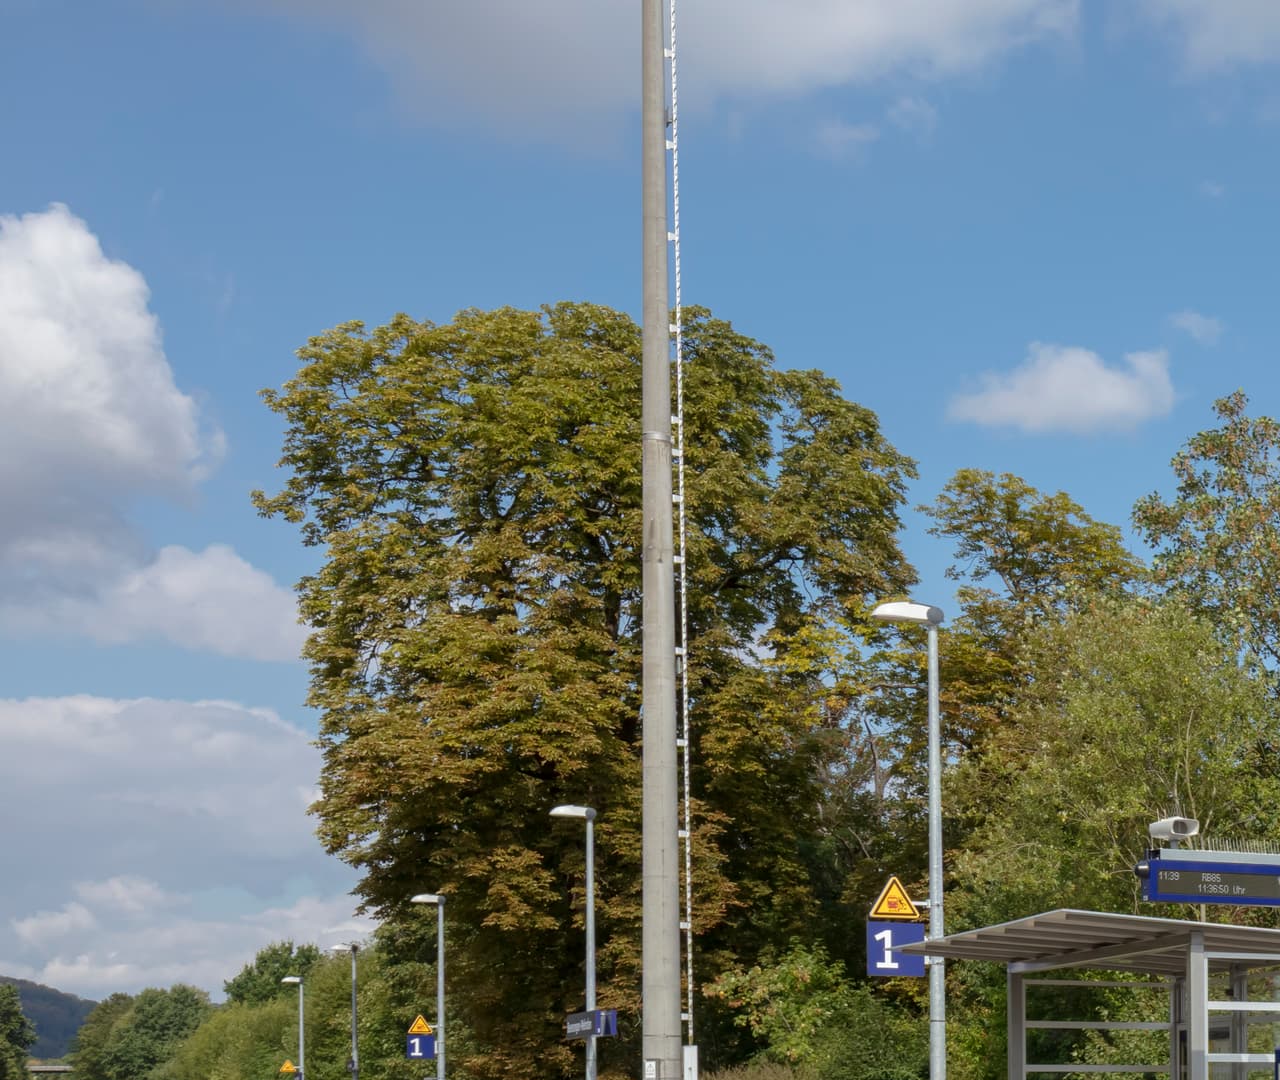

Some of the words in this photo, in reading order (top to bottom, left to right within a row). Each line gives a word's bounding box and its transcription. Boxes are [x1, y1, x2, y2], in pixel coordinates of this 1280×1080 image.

[1233, 886, 1246, 895] Uhr
[874, 929, 899, 969] 1
[410, 1037, 423, 1056] 1
